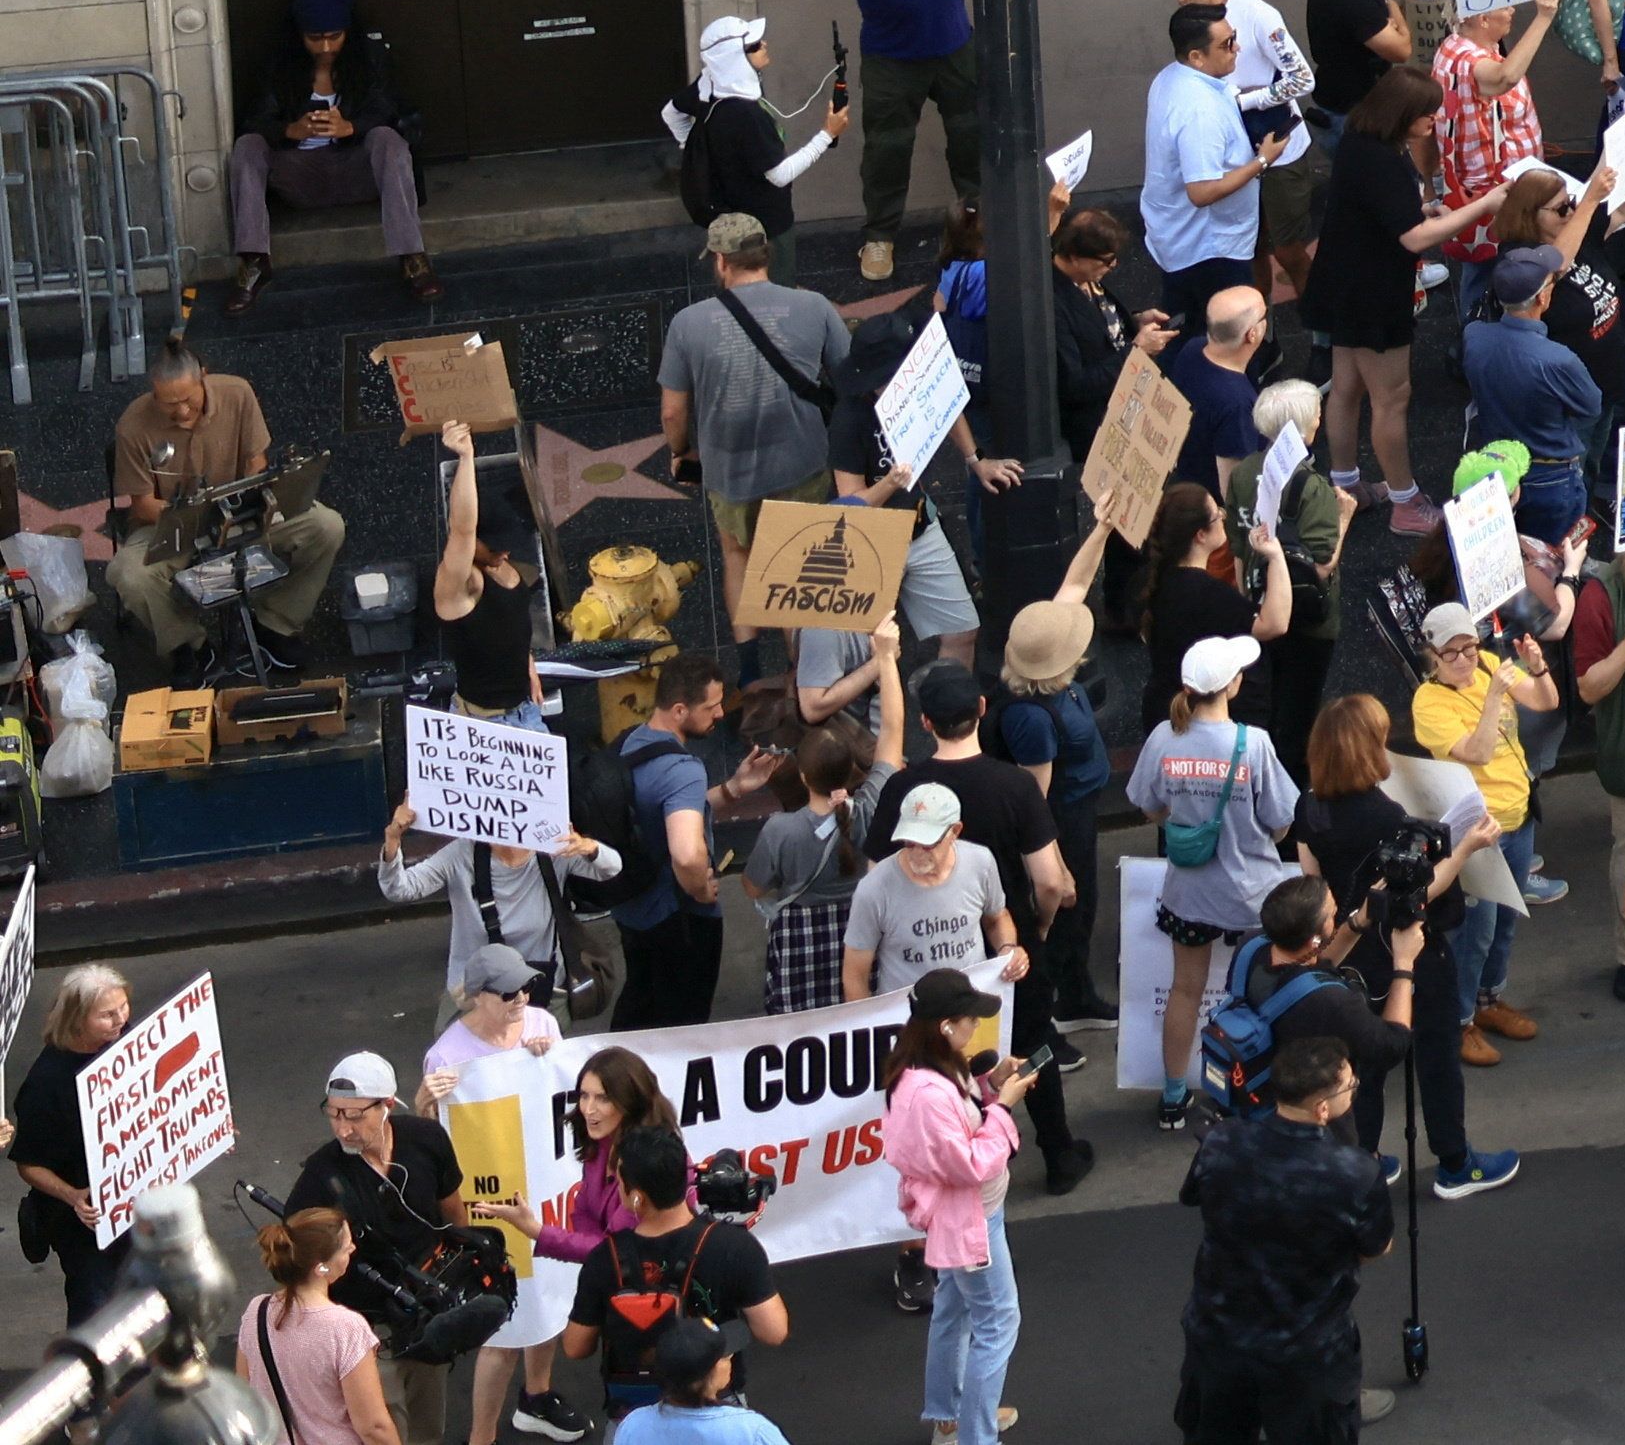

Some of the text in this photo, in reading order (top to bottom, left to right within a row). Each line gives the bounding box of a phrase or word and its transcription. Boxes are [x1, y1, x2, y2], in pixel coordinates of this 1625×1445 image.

[765, 584, 876, 616] FASCISM
[416, 742, 557, 780] TO LOOK A LOT
[467, 726, 555, 762] BEGINNING
[418, 760, 544, 798] LIKE RUSSIA
[442, 788, 528, 819] DUMP
[428, 806, 528, 844] DISNEY
[86, 978, 213, 1110] PROTECT THE
[96, 1069, 151, 1145] FIRST
[102, 1050, 221, 1170] AMENDMENT
[680, 1056, 721, 1128] A
